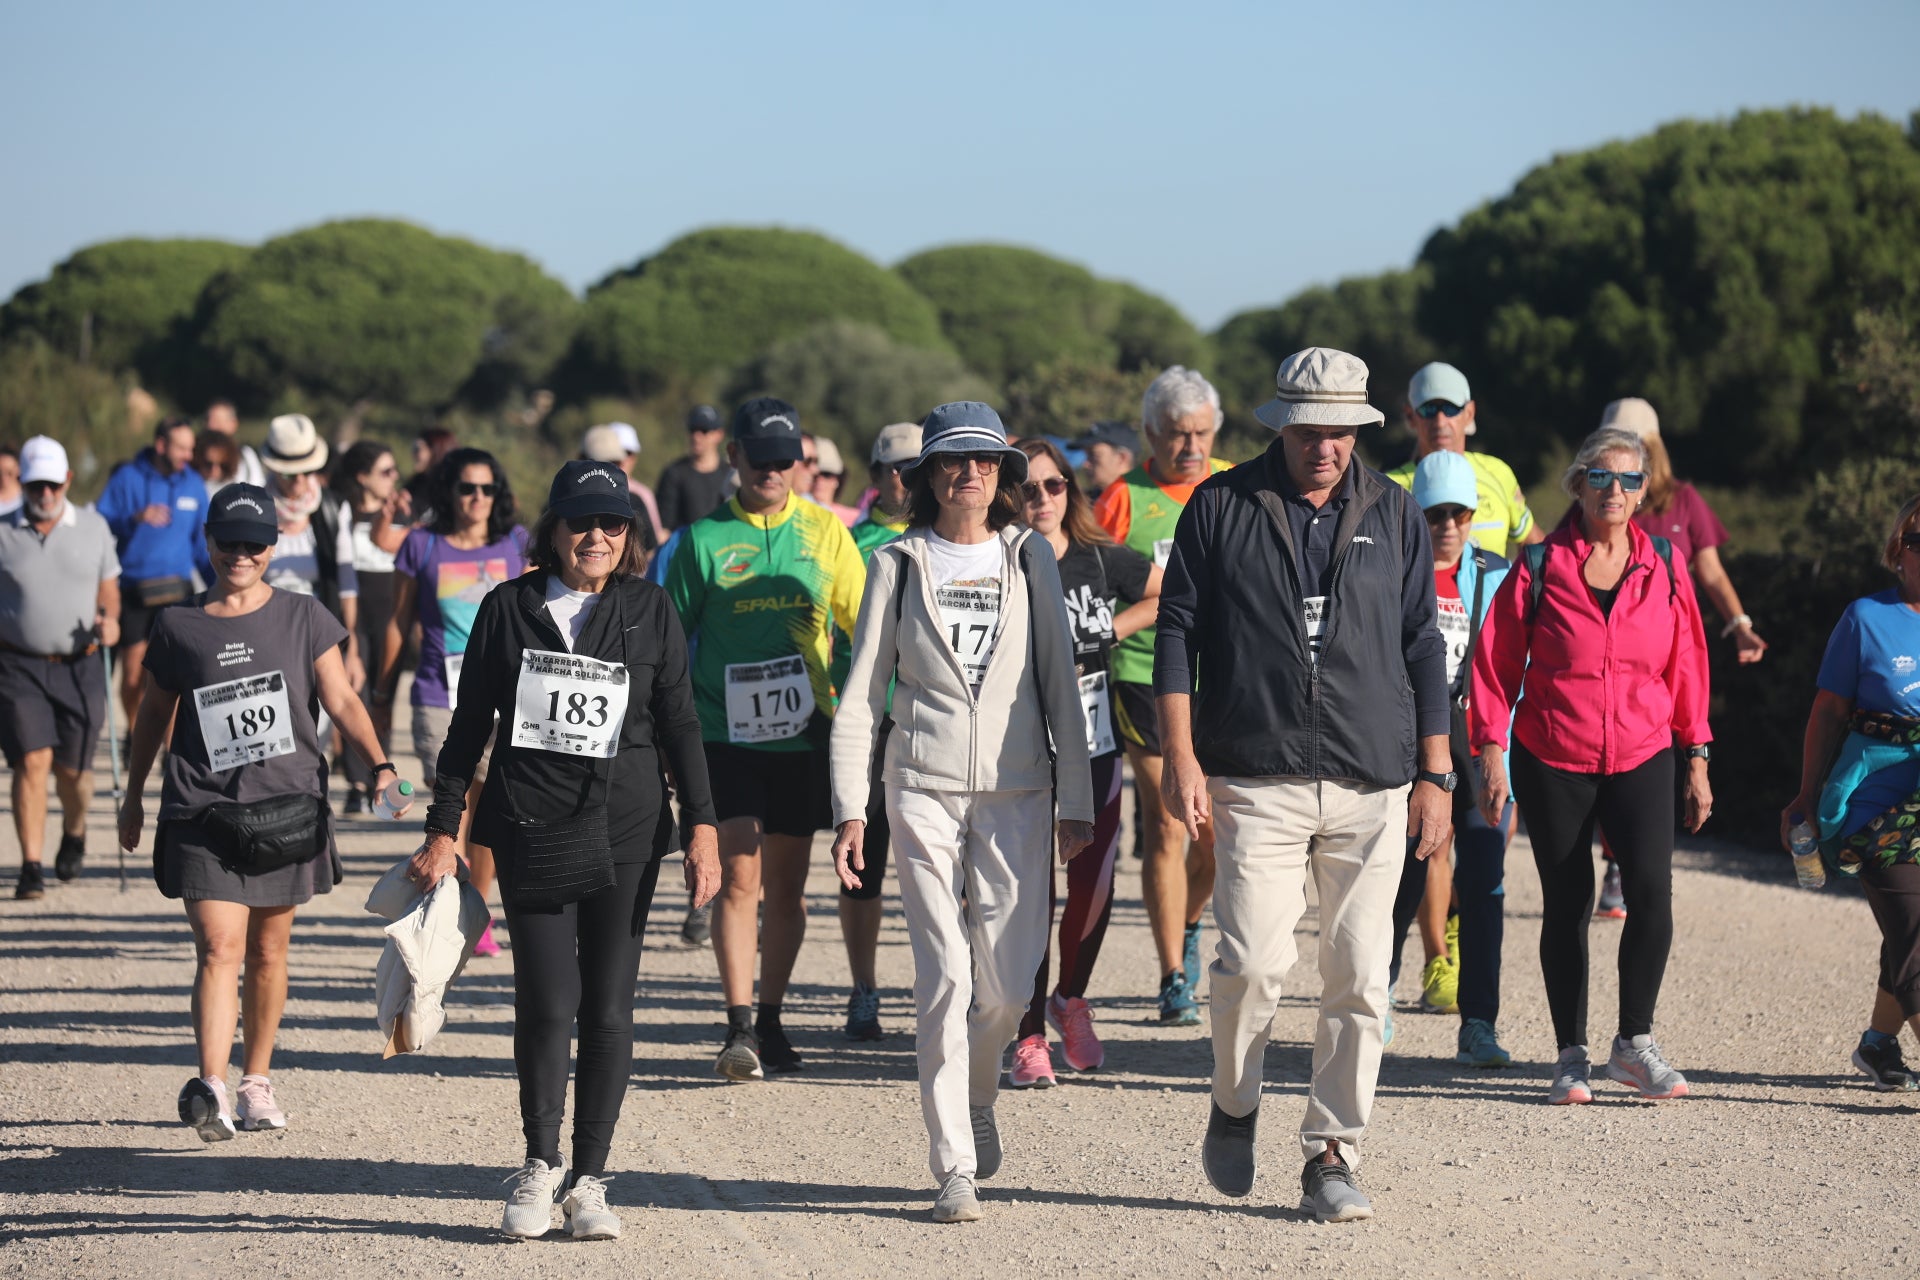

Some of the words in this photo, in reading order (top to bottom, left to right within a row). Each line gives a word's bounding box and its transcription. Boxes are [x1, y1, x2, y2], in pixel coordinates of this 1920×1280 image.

[942, 590, 982, 600] CARRERA
[733, 594, 810, 615] SPALL
[947, 622, 995, 655] 17
[225, 642, 245, 650] Being
[216, 649, 246, 660] different
[247, 647, 255, 655] is
[220, 655, 253, 667] beautiful.
[530, 655, 540, 663] VII
[543, 656, 584, 669] CARRERA
[535, 665, 572, 677] MARCHA
[575, 670, 613, 682] SOLIDAR
[212, 682, 245, 697] CARRERA
[207, 693, 238, 706] MARCHA
[750, 686, 801, 718] 170
[545, 690, 609, 728] 183
[225, 704, 276, 741] 189
[529, 722, 540, 730] NB
